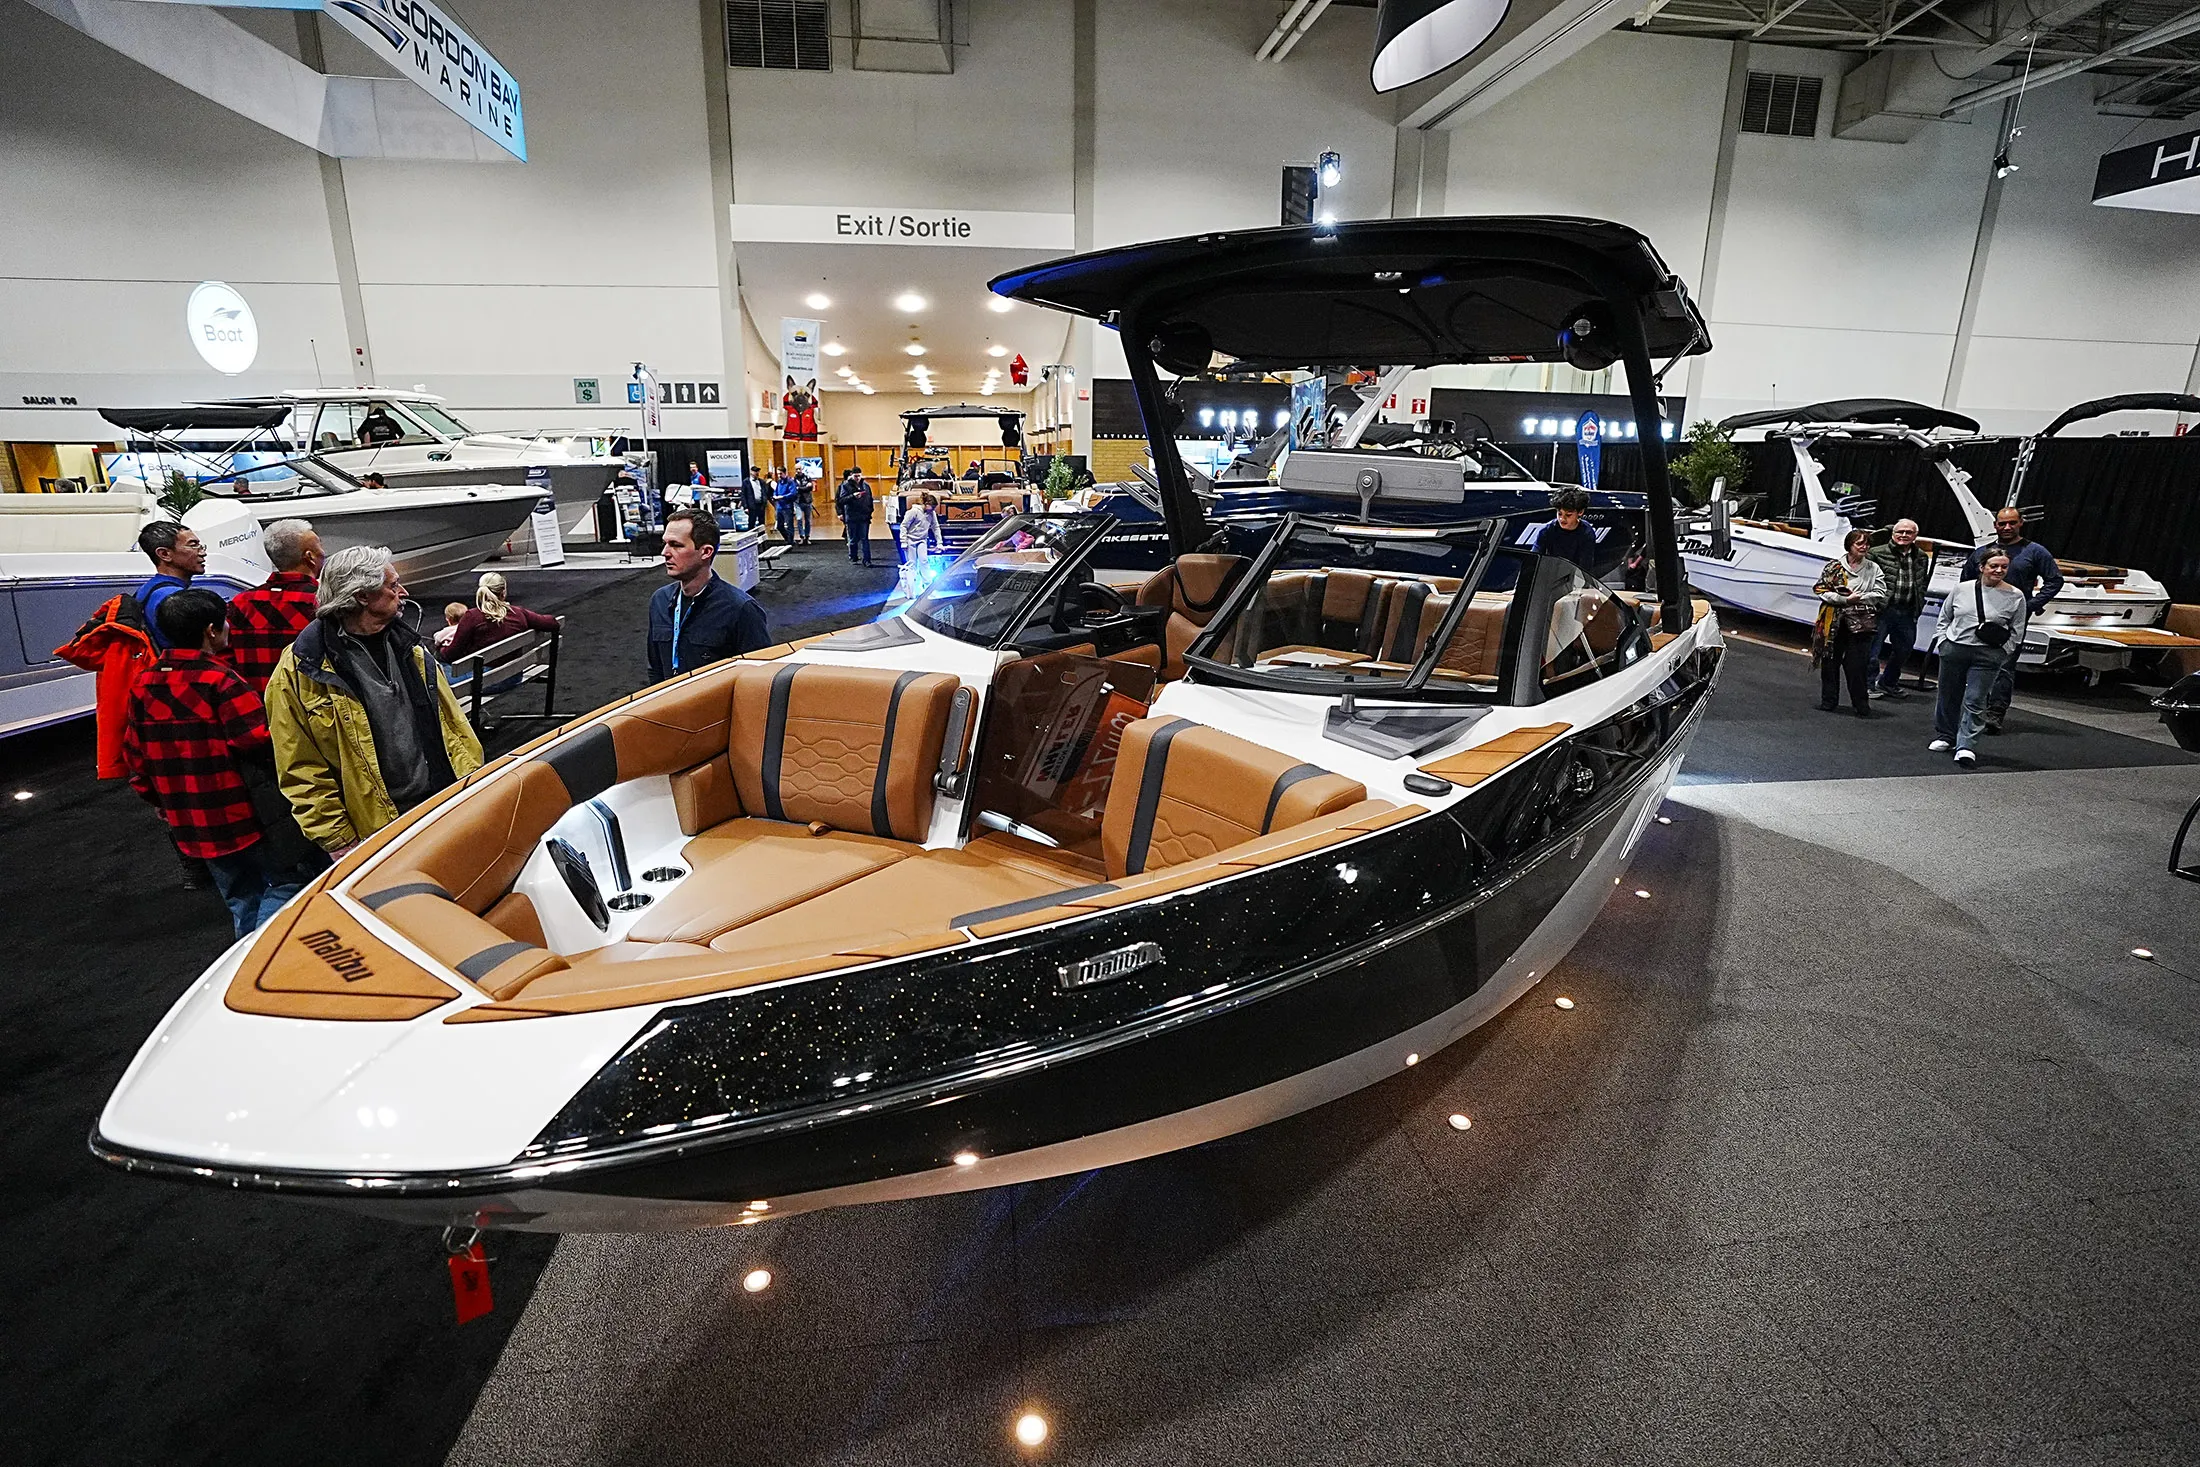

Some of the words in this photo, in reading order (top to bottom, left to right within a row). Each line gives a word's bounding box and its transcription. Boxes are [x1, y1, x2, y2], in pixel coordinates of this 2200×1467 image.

[393, 0, 487, 90] GORDON
[491, 70, 518, 116] BAY
[414, 41, 513, 138] MARINE
[203, 324, 244, 342] Boat
[22, 396, 57, 405] SALON
[1523, 418, 1577, 436] THE
[219, 530, 257, 548] MERCURY
[298, 929, 375, 983] Malibu
